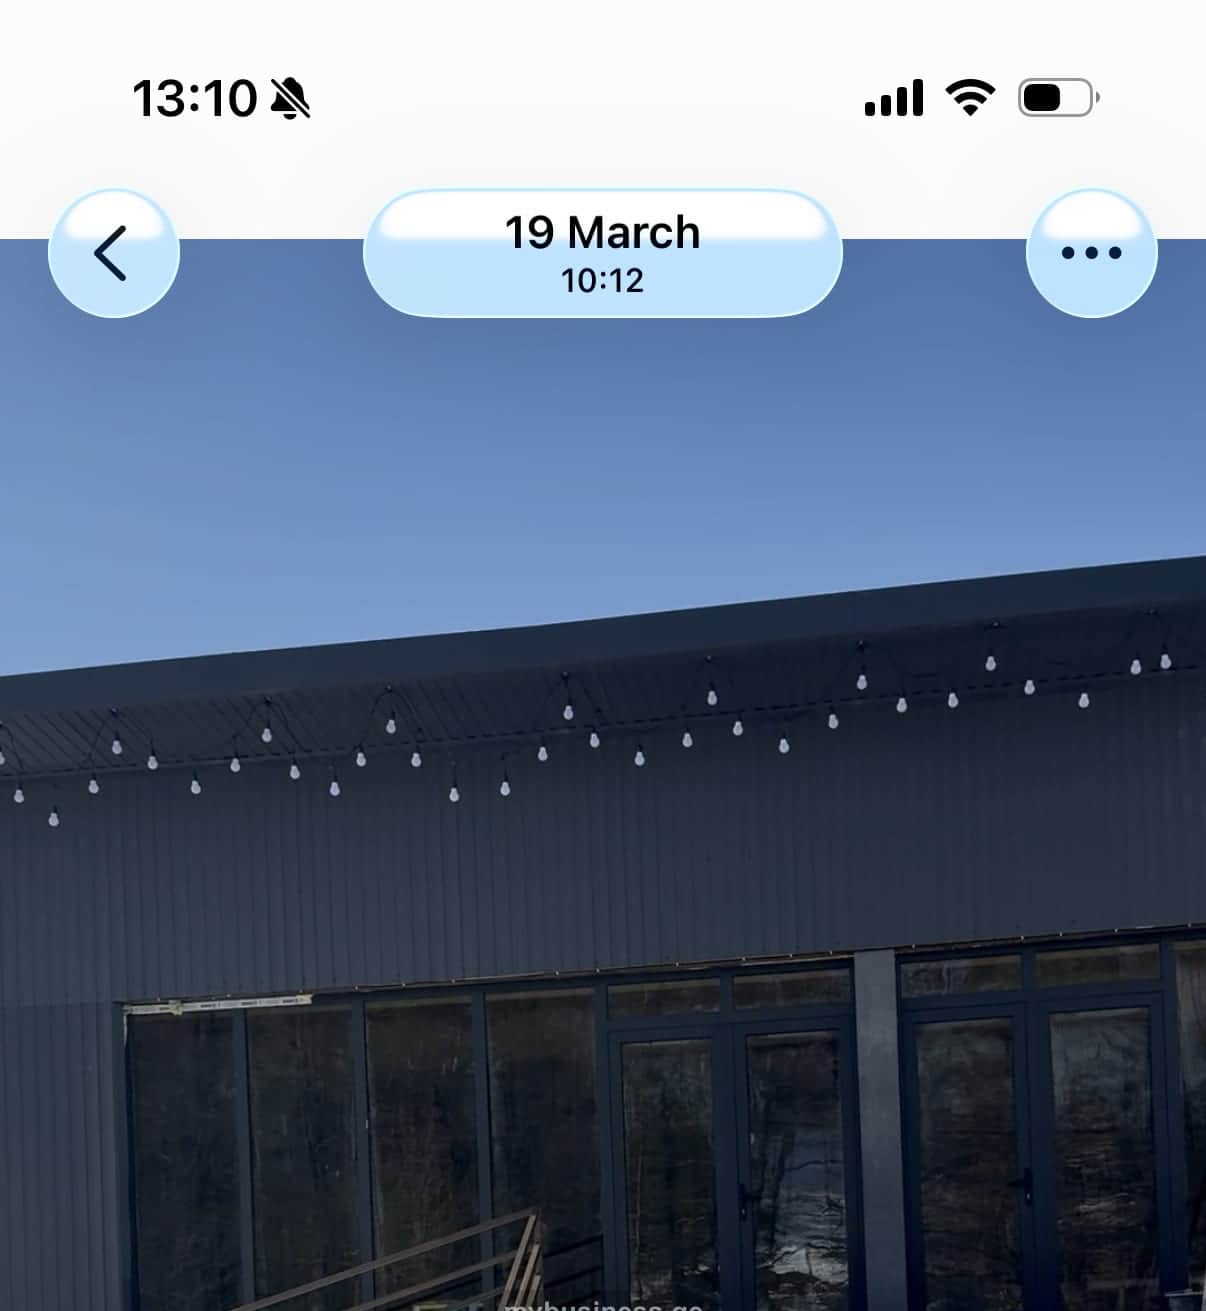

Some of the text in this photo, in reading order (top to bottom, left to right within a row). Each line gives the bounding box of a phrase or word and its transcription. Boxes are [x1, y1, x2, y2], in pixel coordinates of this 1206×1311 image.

[133, 78, 258, 118] 13:10
[506, 214, 700, 250] 19 March
[561, 267, 644, 293] 10:12
